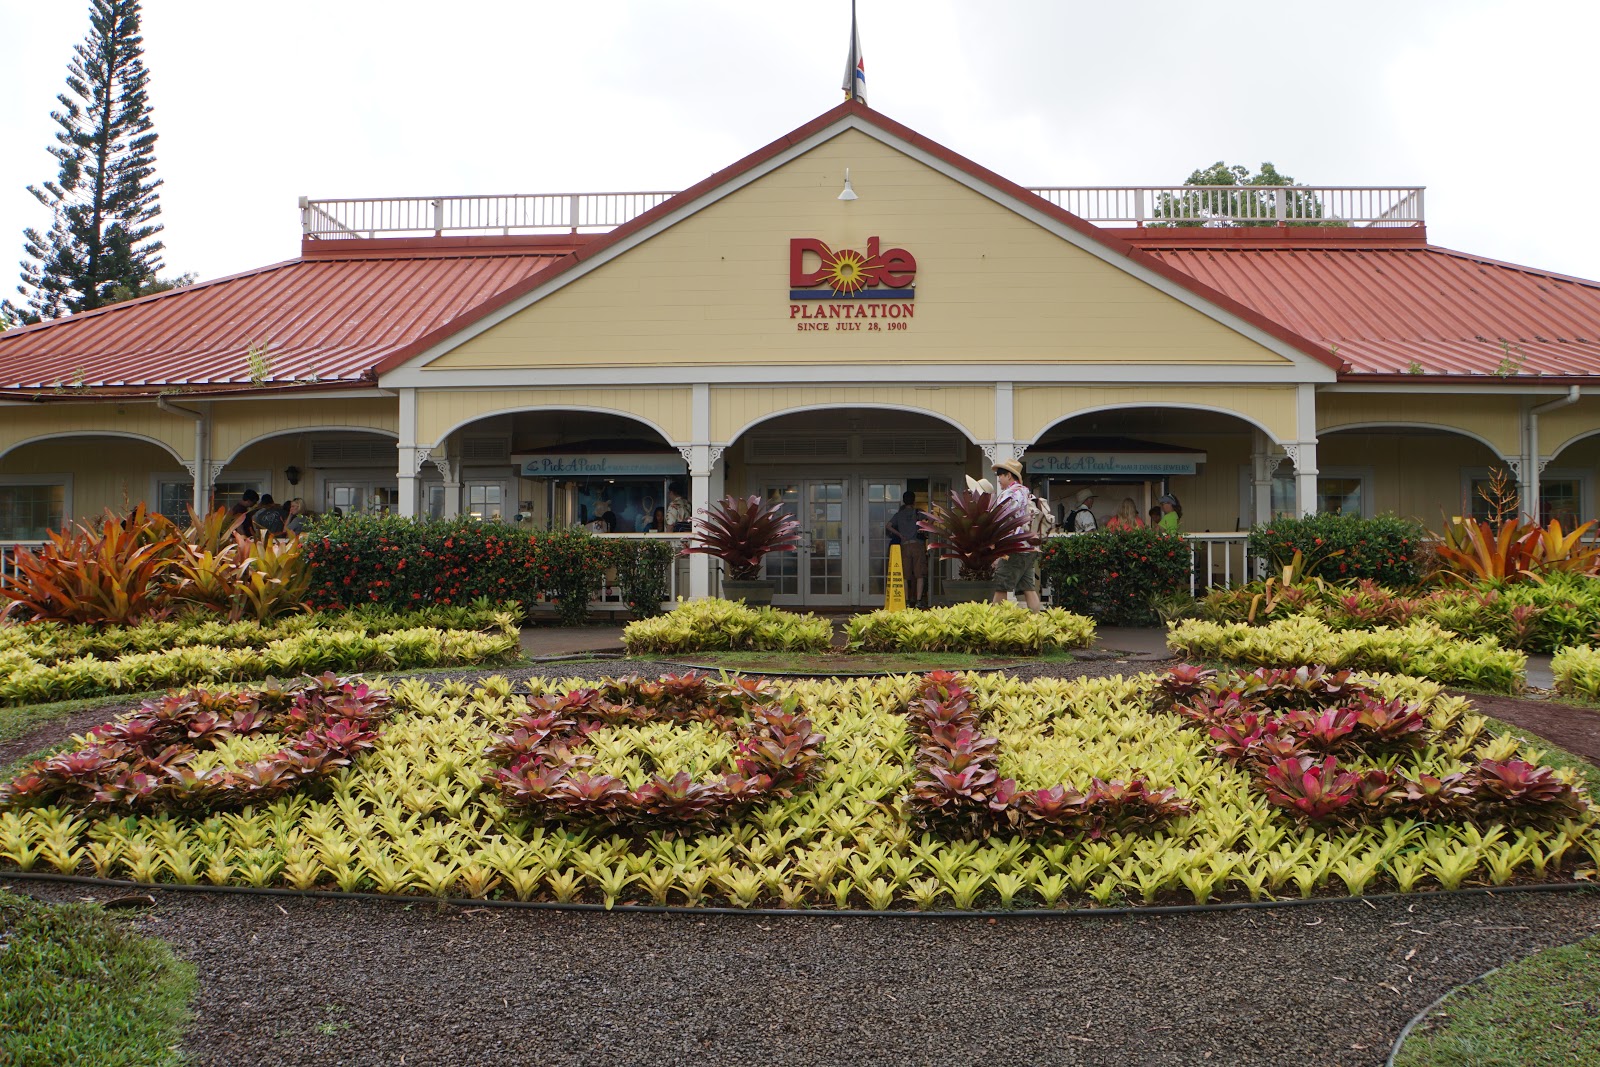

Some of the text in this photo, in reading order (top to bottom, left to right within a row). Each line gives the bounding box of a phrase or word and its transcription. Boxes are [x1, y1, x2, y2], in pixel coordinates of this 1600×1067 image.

[790, 236, 916, 292] Dole
[790, 304, 914, 319] PLANTATION
[797, 322, 907, 332] SINCE JULY 28, 1900
[541, 459, 564, 472] Pick
[578, 458, 607, 472] Pearl
[1048, 457, 1071, 470] Pick
[1085, 456, 1115, 470] Pearl
